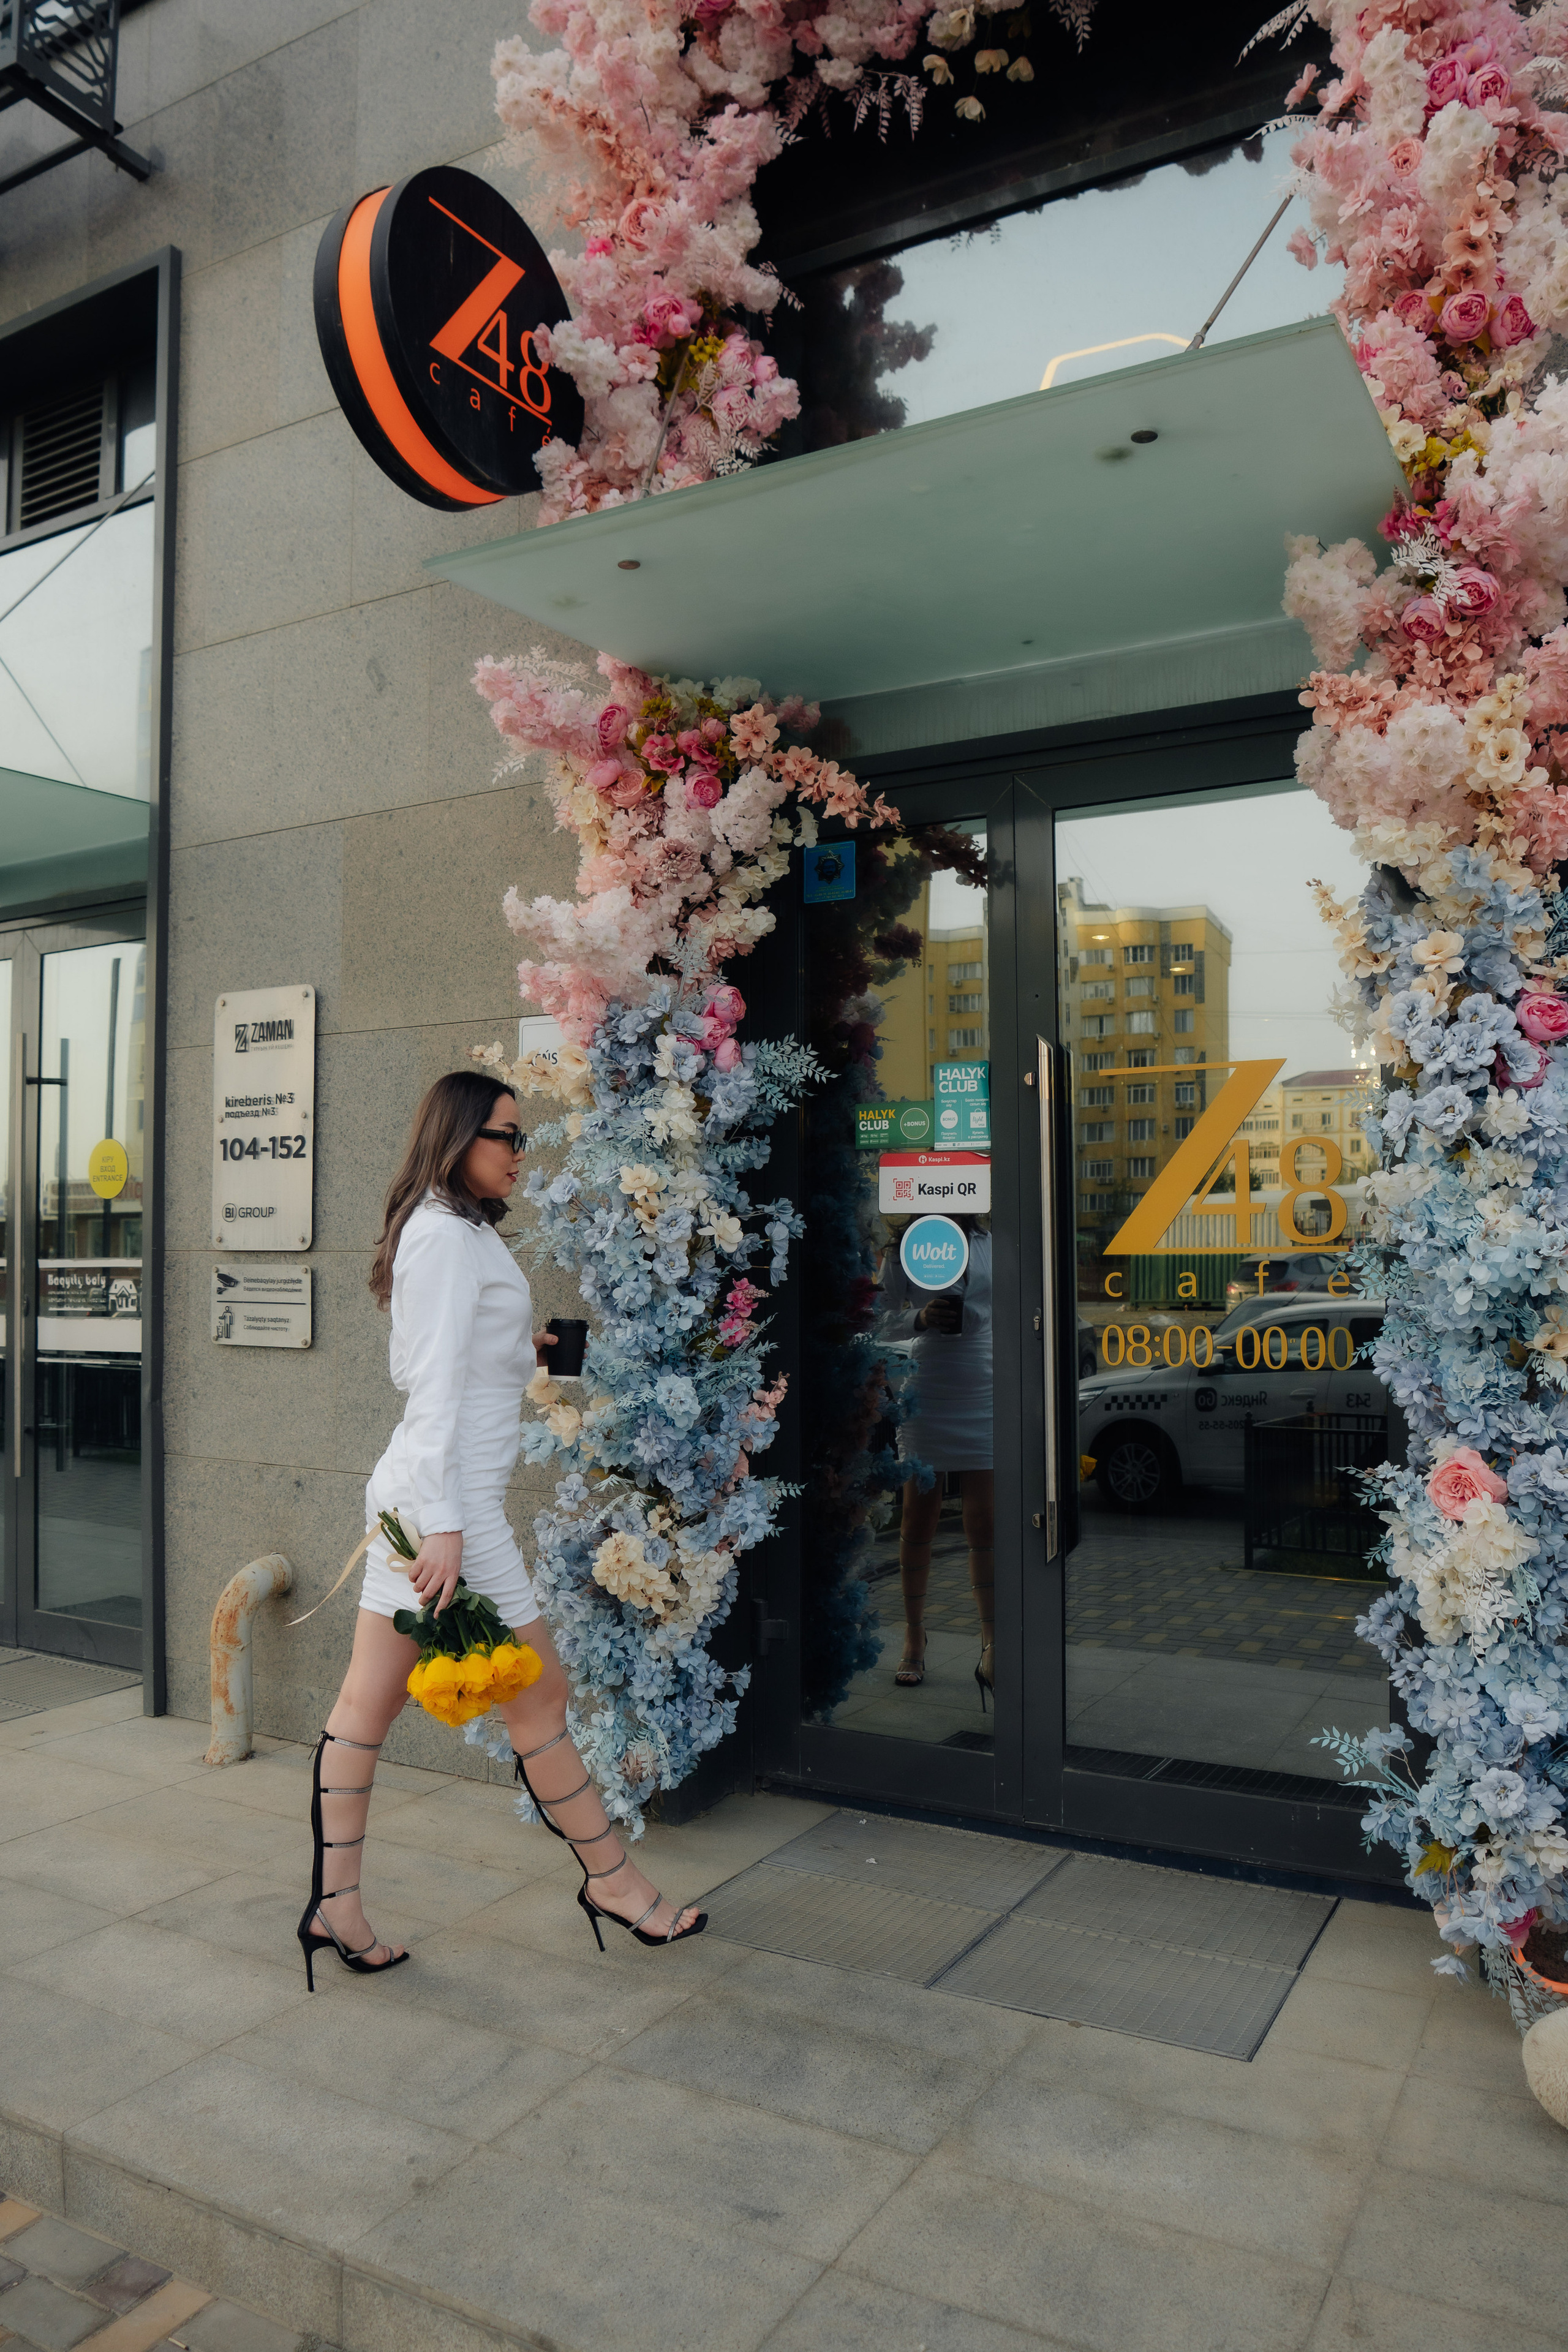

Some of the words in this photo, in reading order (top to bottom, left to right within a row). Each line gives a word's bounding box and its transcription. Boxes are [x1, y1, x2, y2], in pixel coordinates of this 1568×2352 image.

[429, 195, 552, 426] Z48
[251, 1019, 292, 1042] ZAMAN
[939, 1067, 986, 1080] HALYK
[939, 1080, 978, 1093] CLUB
[225, 1094, 271, 1107] kireberis
[276, 1093, 295, 1104] №3
[225, 1110, 259, 1118] подъезд
[262, 1107, 276, 1116] №3
[859, 1109, 895, 1120] HALYK
[859, 1120, 889, 1131] CLUB
[220, 1134, 306, 1161] 104-152
[1099, 1058, 1349, 1255] Z48
[918, 1183, 954, 1197] Kaspi
[957, 1183, 976, 1196] QR
[225, 1207, 234, 1218] BI
[238, 1207, 274, 1218] GROUP
[912, 1242, 957, 1261] Wolt
[1102, 1324, 1354, 1371] 08:00-0000
